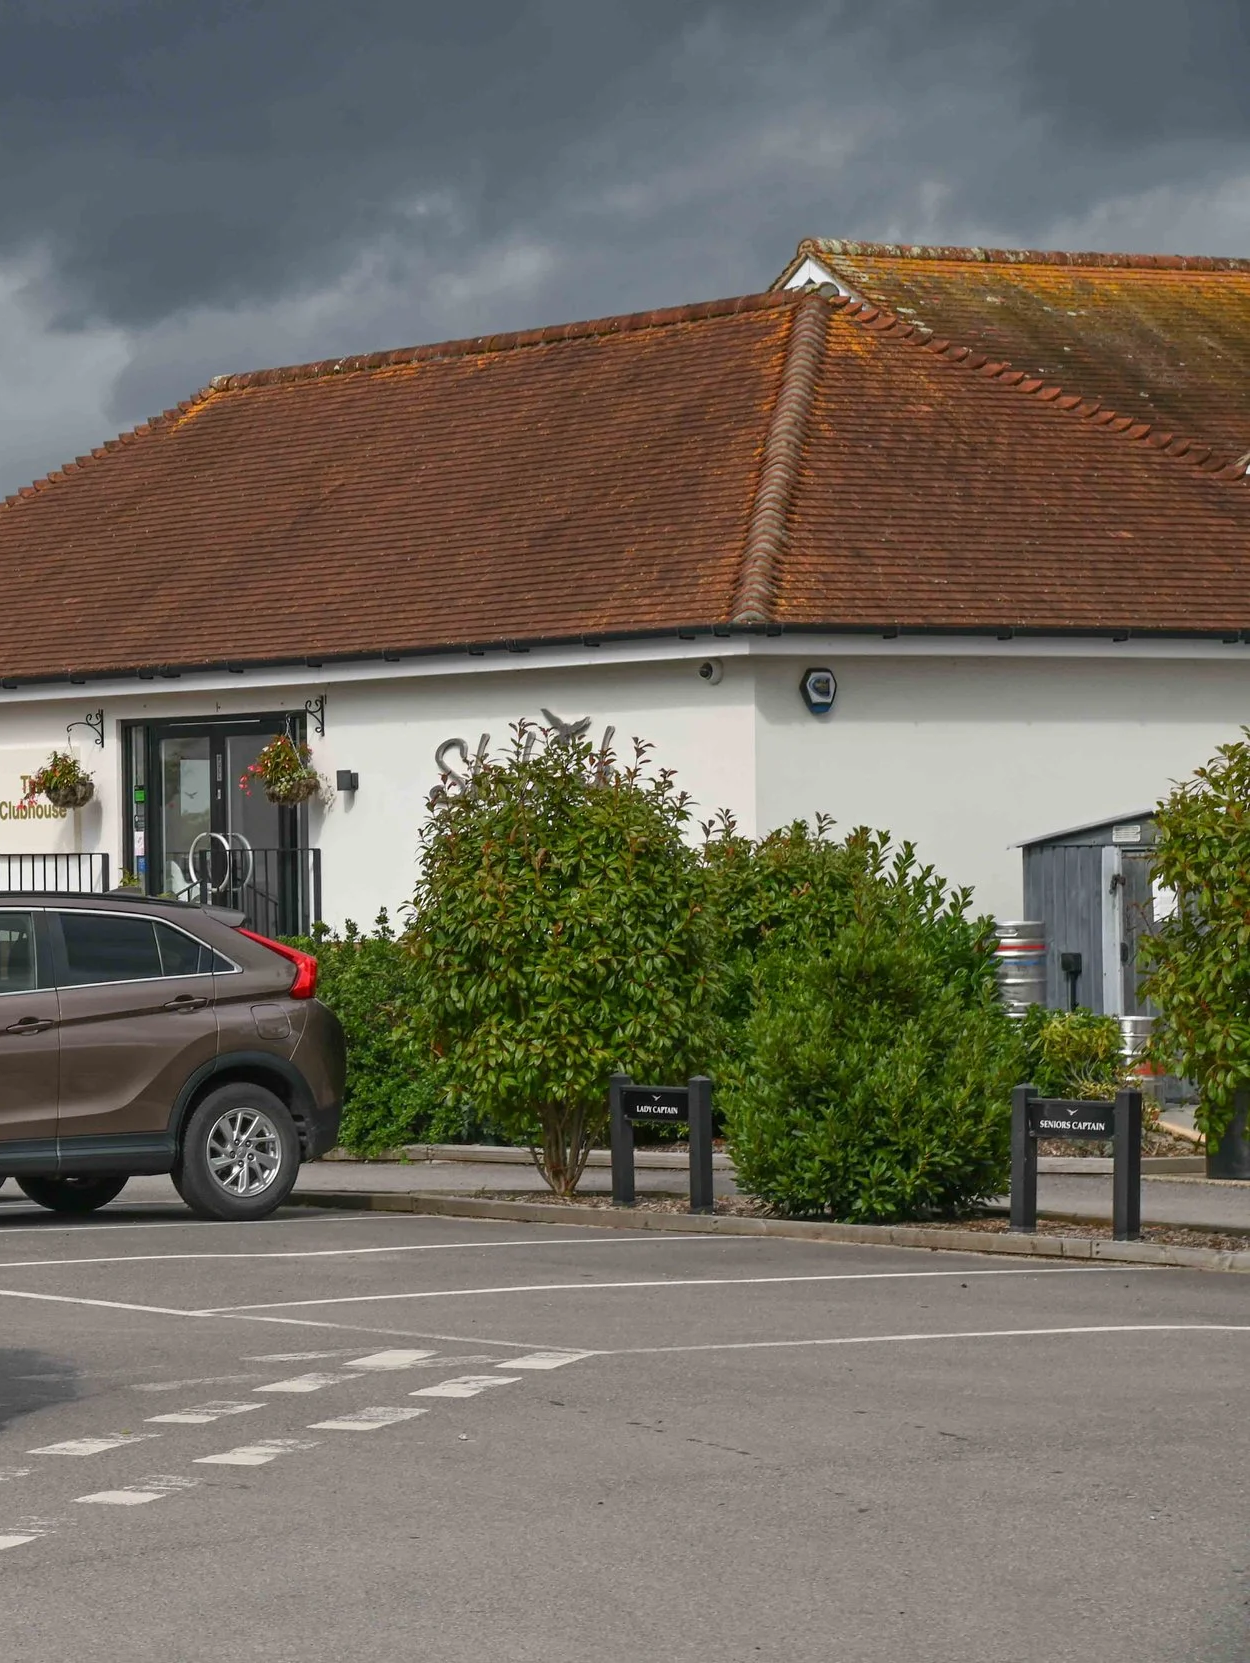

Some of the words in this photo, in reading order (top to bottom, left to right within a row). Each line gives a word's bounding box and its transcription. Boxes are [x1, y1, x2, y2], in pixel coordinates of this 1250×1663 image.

[0, 801, 67, 820] Clubhouse
[636, 1105, 652, 1113] LADY
[652, 1106, 679, 1114] CAPTAIN
[1039, 1120, 1071, 1129] SENIORS
[1072, 1121, 1106, 1131] CAPTAIN
